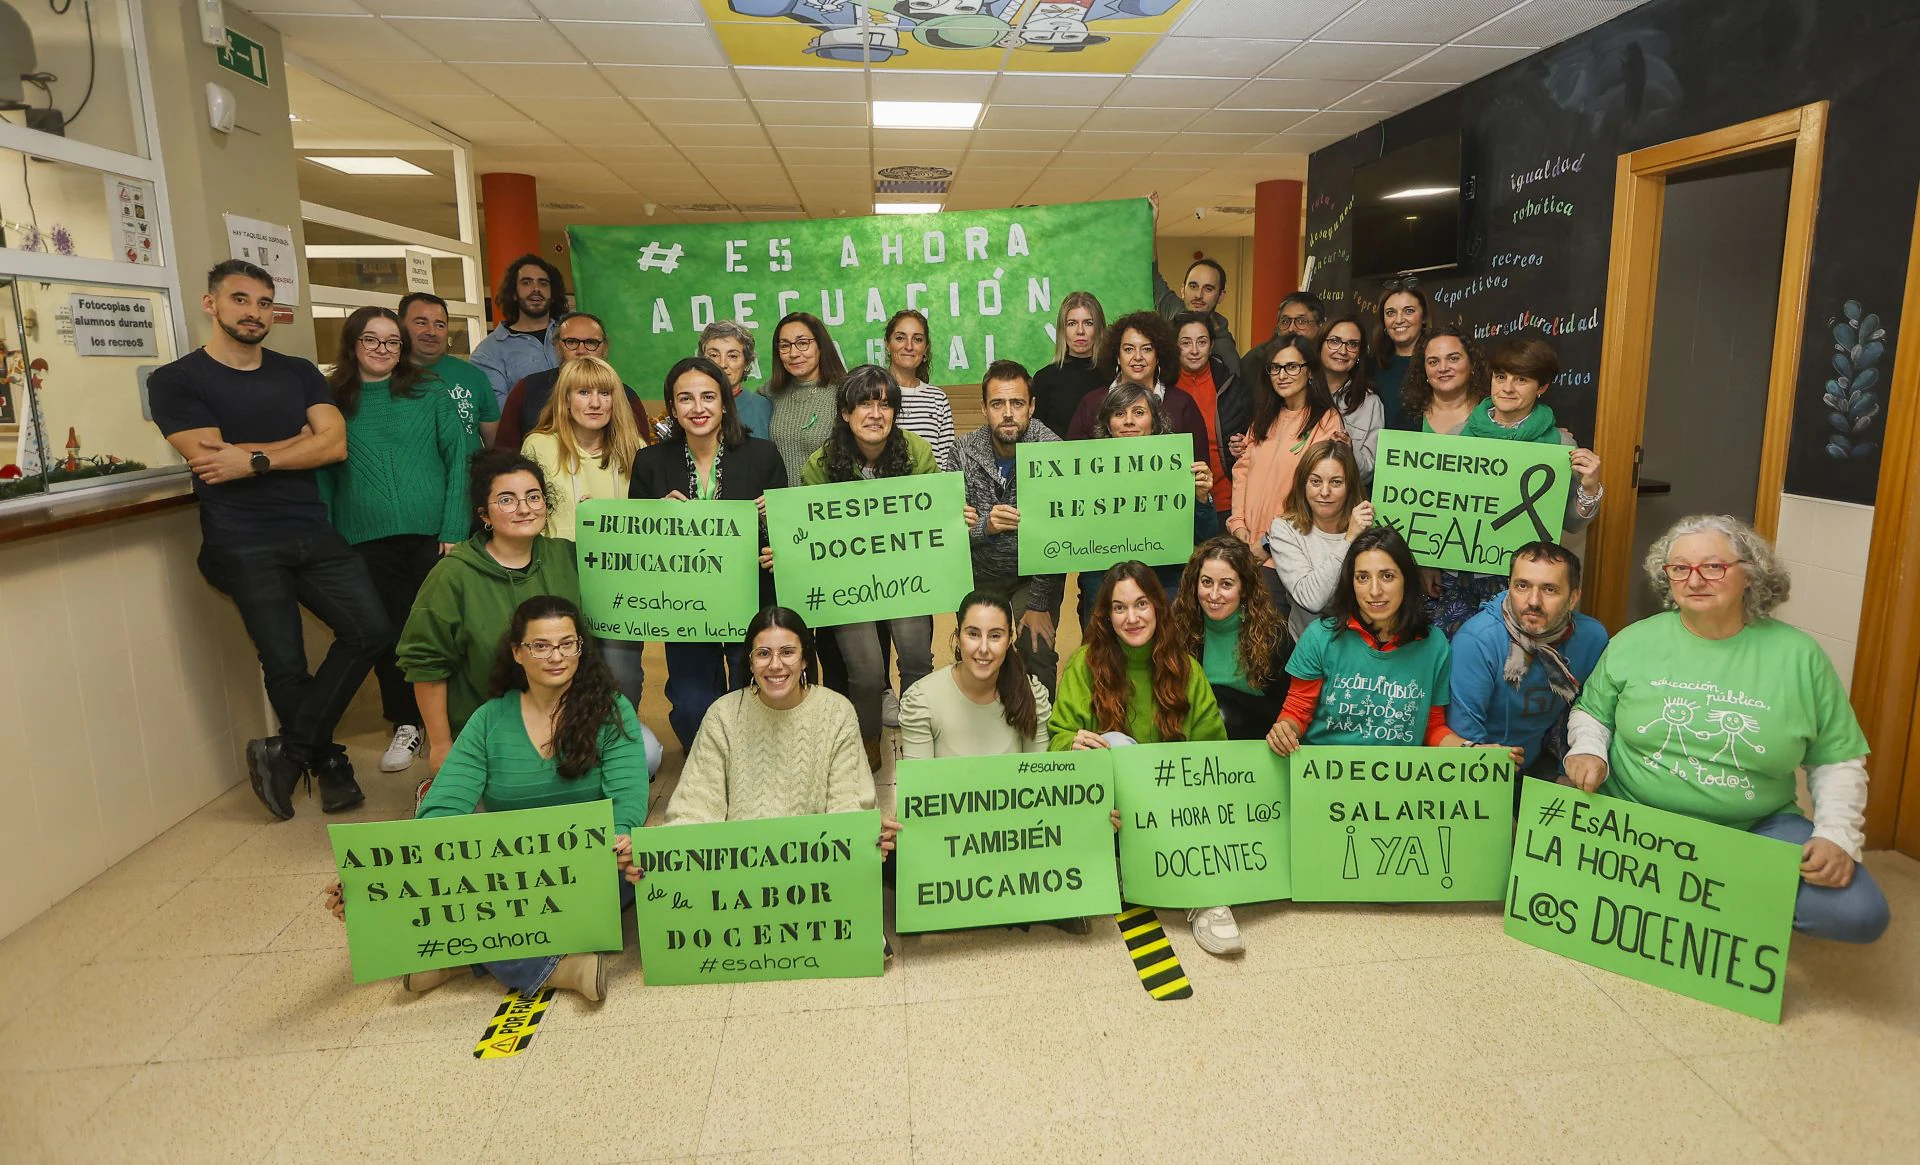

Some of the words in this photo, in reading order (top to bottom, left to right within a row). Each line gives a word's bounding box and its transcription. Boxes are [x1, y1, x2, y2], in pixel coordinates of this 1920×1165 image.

[1511, 153, 1585, 192] igualdad
[1512, 195, 1574, 224] robótica
[726, 238, 792, 273] ES
[840, 223, 1030, 268] AHORA
[1492, 253, 1543, 268] recreos
[78, 298, 130, 313] Fotocopias
[134, 303, 146, 313] de
[652, 267, 1051, 334] ADECUACIÓN
[1434, 276, 1508, 308] deportivos
[75, 316, 116, 327] alumnos
[118, 318, 153, 329] durante
[1474, 307, 1599, 340] interculturalidad
[91, 336, 106, 347] los
[108, 338, 144, 347] recreoS
[1028, 453, 1183, 479] EXIGIMOS
[1386, 448, 1508, 477] ENCIERRO
[807, 492, 933, 522] RESPETO
[1049, 493, 1187, 519] RESPETO
[1382, 485, 1500, 515] DOCENTE
[792, 527, 808, 545] al
[809, 528, 945, 561] DOCENTE
[1043, 537, 1165, 559] @9vallesenlucha
[1375, 511, 1514, 566] #EsAhor
[612, 590, 708, 611] #esahora
[804, 574, 930, 611] #esahora
[624, 621, 670, 638] Valles
[676, 625, 697, 637] en
[1650, 678, 1718, 694] educación
[1018, 761, 1076, 774] #esahora
[1302, 752, 1510, 784] ADECUACIÓN
[904, 783, 1105, 819] REIVINDICANDO
[1135, 811, 1158, 829] LA
[1171, 805, 1212, 828] HORA
[1217, 803, 1236, 825] DE
[1246, 800, 1282, 823] L@S
[1329, 799, 1490, 823] SALARIAL
[944, 819, 1062, 858] TAMBIÉN
[1538, 797, 1699, 862] #EsAhora
[341, 823, 607, 869] ADECUACIÓN
[638, 830, 852, 873] DIGNIFICACIÓN
[1154, 841, 1268, 878] DOCENTES
[366, 865, 577, 902] SALARIAL
[1525, 828, 1562, 867] LA
[1577, 843, 1661, 893] HORA
[1679, 870, 1726, 912] DE
[647, 882, 668, 902] de
[671, 891, 693, 910] la
[711, 881, 832, 911] LABOR
[918, 867, 1083, 906] EDUCAMOS
[411, 895, 563, 928] JUSTA
[667, 918, 852, 950] DOCENTE
[1509, 874, 1579, 935] L@S
[1590, 895, 1780, 994] DOCENTES
[699, 952, 820, 974] #esahora
[509, 993, 540, 1014] FAV
[498, 1015, 528, 1035] POR
